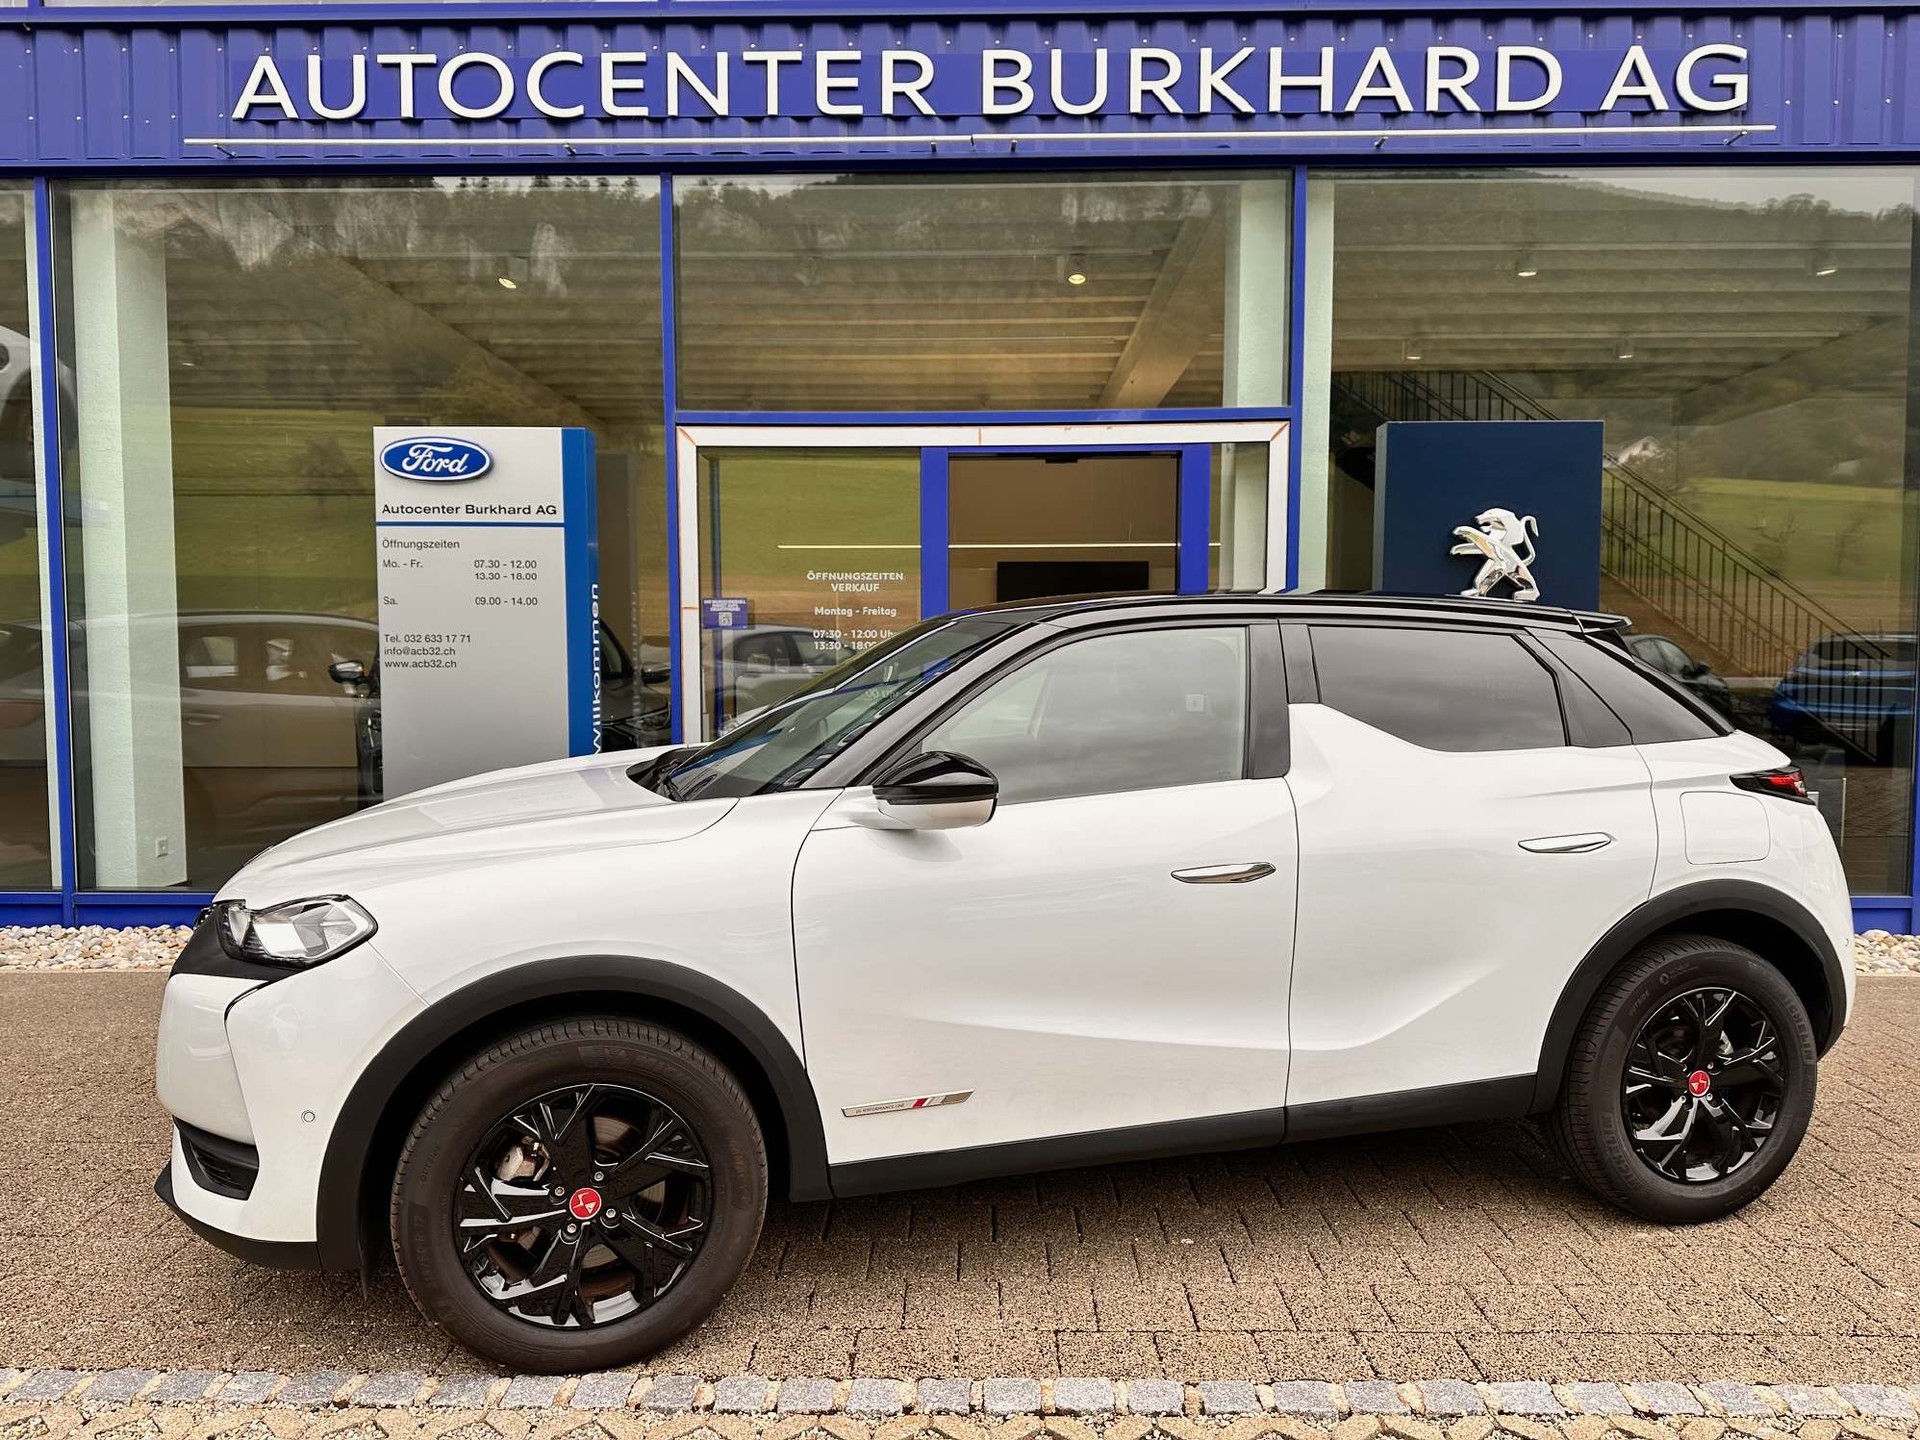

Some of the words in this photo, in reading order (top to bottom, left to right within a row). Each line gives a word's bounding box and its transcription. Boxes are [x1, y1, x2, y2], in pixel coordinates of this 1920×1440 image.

[231, 49, 937, 120] AUTOCENTER
[981, 45, 1563, 116] BURKHARD
[1600, 43, 1749, 113] AG
[402, 444, 469, 473] Ford
[382, 504, 461, 515] Autocenter
[465, 504, 532, 515] Burkhard
[536, 505, 557, 515] AG
[382, 538, 460, 550] Öffnungszeiten
[382, 560, 400, 568] Mo.
[410, 560, 423, 568] Fr.
[474, 560, 500, 569] 07.30
[510, 560, 537, 569] 12.00
[475, 572, 500, 581] 13.30
[511, 572, 538, 581] 18.00
[807, 570, 904, 581] ÖFFNUNGSZEITEN
[831, 583, 880, 592] VERKAUF
[383, 596, 399, 605] Sa.
[475, 597, 501, 606] 09.00
[511, 597, 538, 606] 14.00
[814, 606, 853, 617] Montag
[862, 606, 897, 617] Freitag
[384, 634, 401, 643] Tel.
[404, 634, 422, 643] 032
[425, 634, 443, 643] 633
[446, 634, 457, 643] 17
[460, 634, 471, 643] 71
[812, 629, 842, 639] 07:30
[851, 629, 878, 639] 12:00
[813, 641, 842, 650] 13:30
[384, 646, 456, 656] info@acb32.ch
[384, 660, 457, 669] www.acb32.ch
